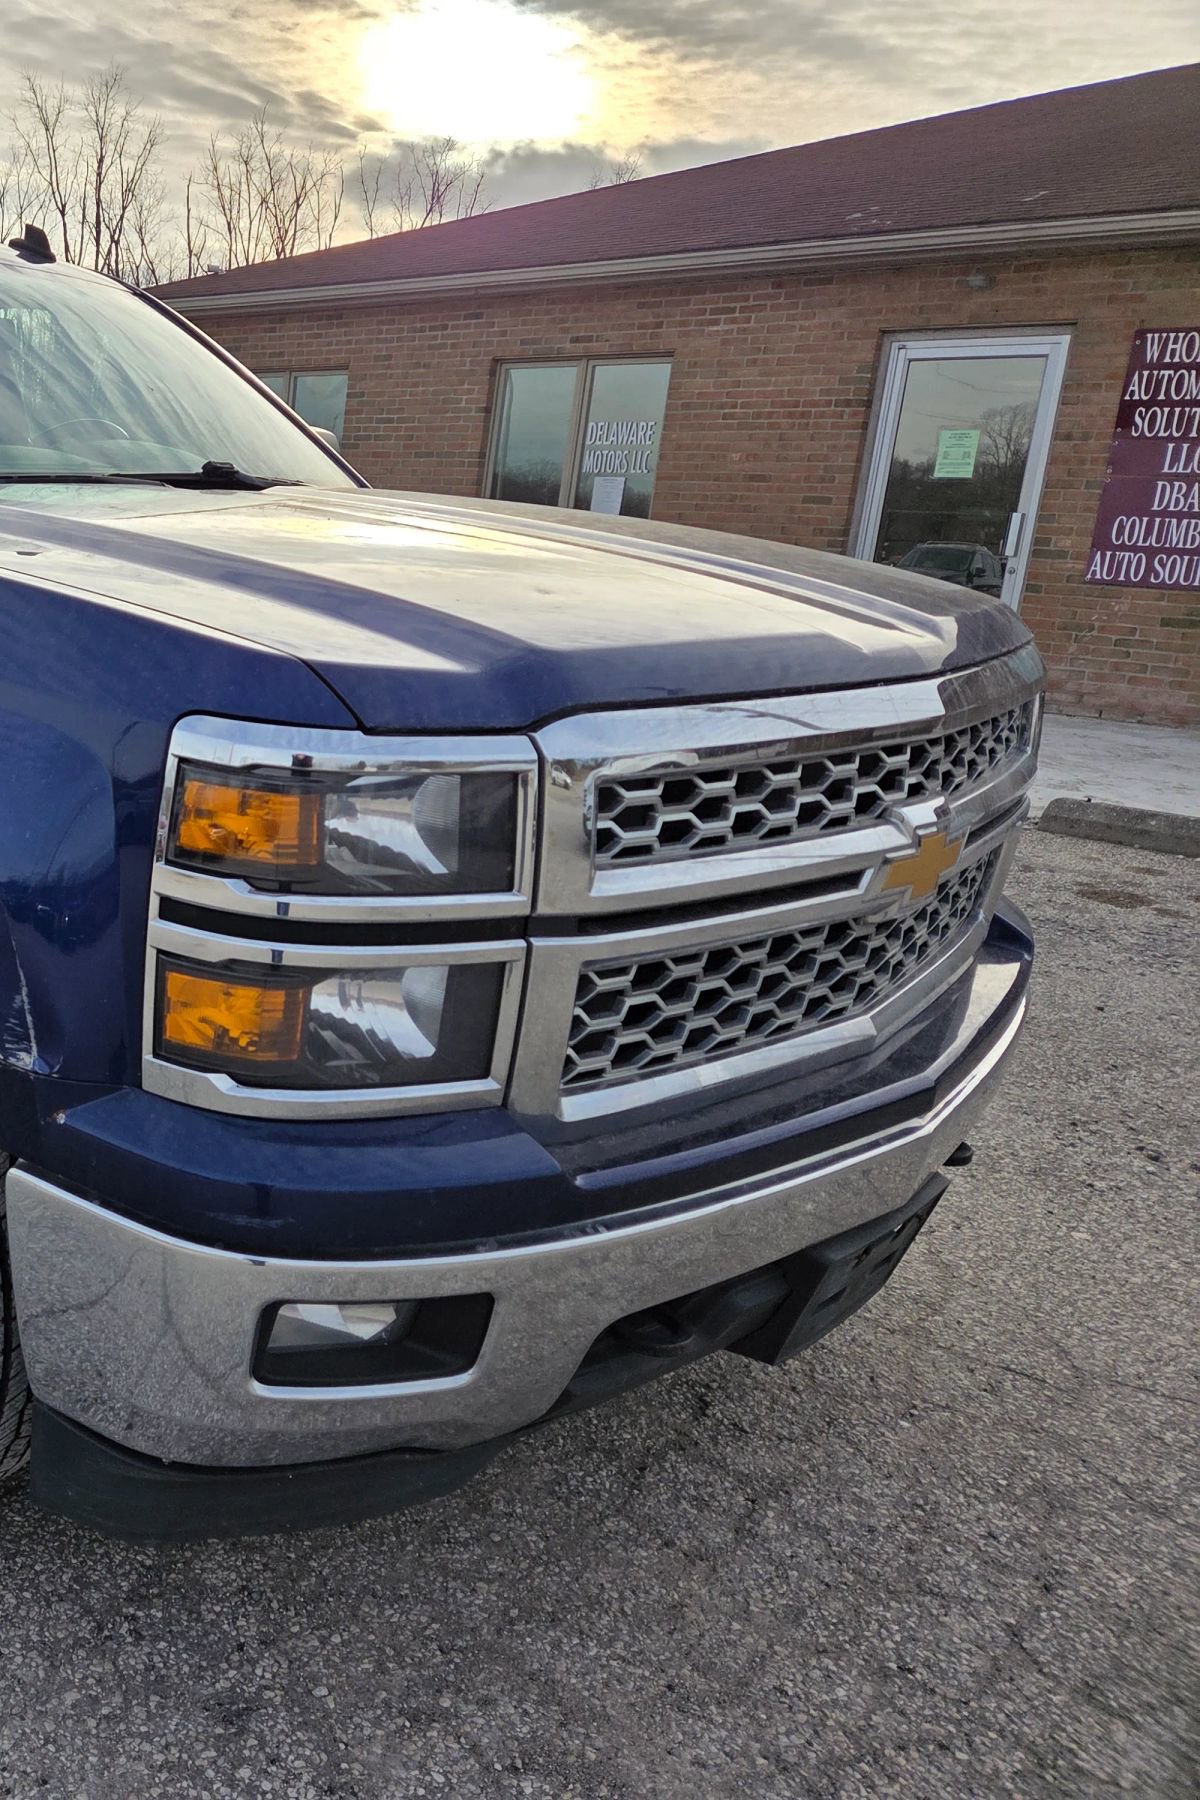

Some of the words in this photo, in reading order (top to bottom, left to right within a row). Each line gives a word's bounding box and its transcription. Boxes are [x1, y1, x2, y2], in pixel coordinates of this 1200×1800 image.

[1145, 331, 1200, 363] WHO
[586, 421, 656, 445] DELAWARE
[583, 449, 629, 474] MOTORS
[630, 449, 651, 474] LLC
[1151, 481, 1200, 512] DBA
[1111, 515, 1200, 549] COLUMB
[1087, 550, 1147, 582] AUTO
